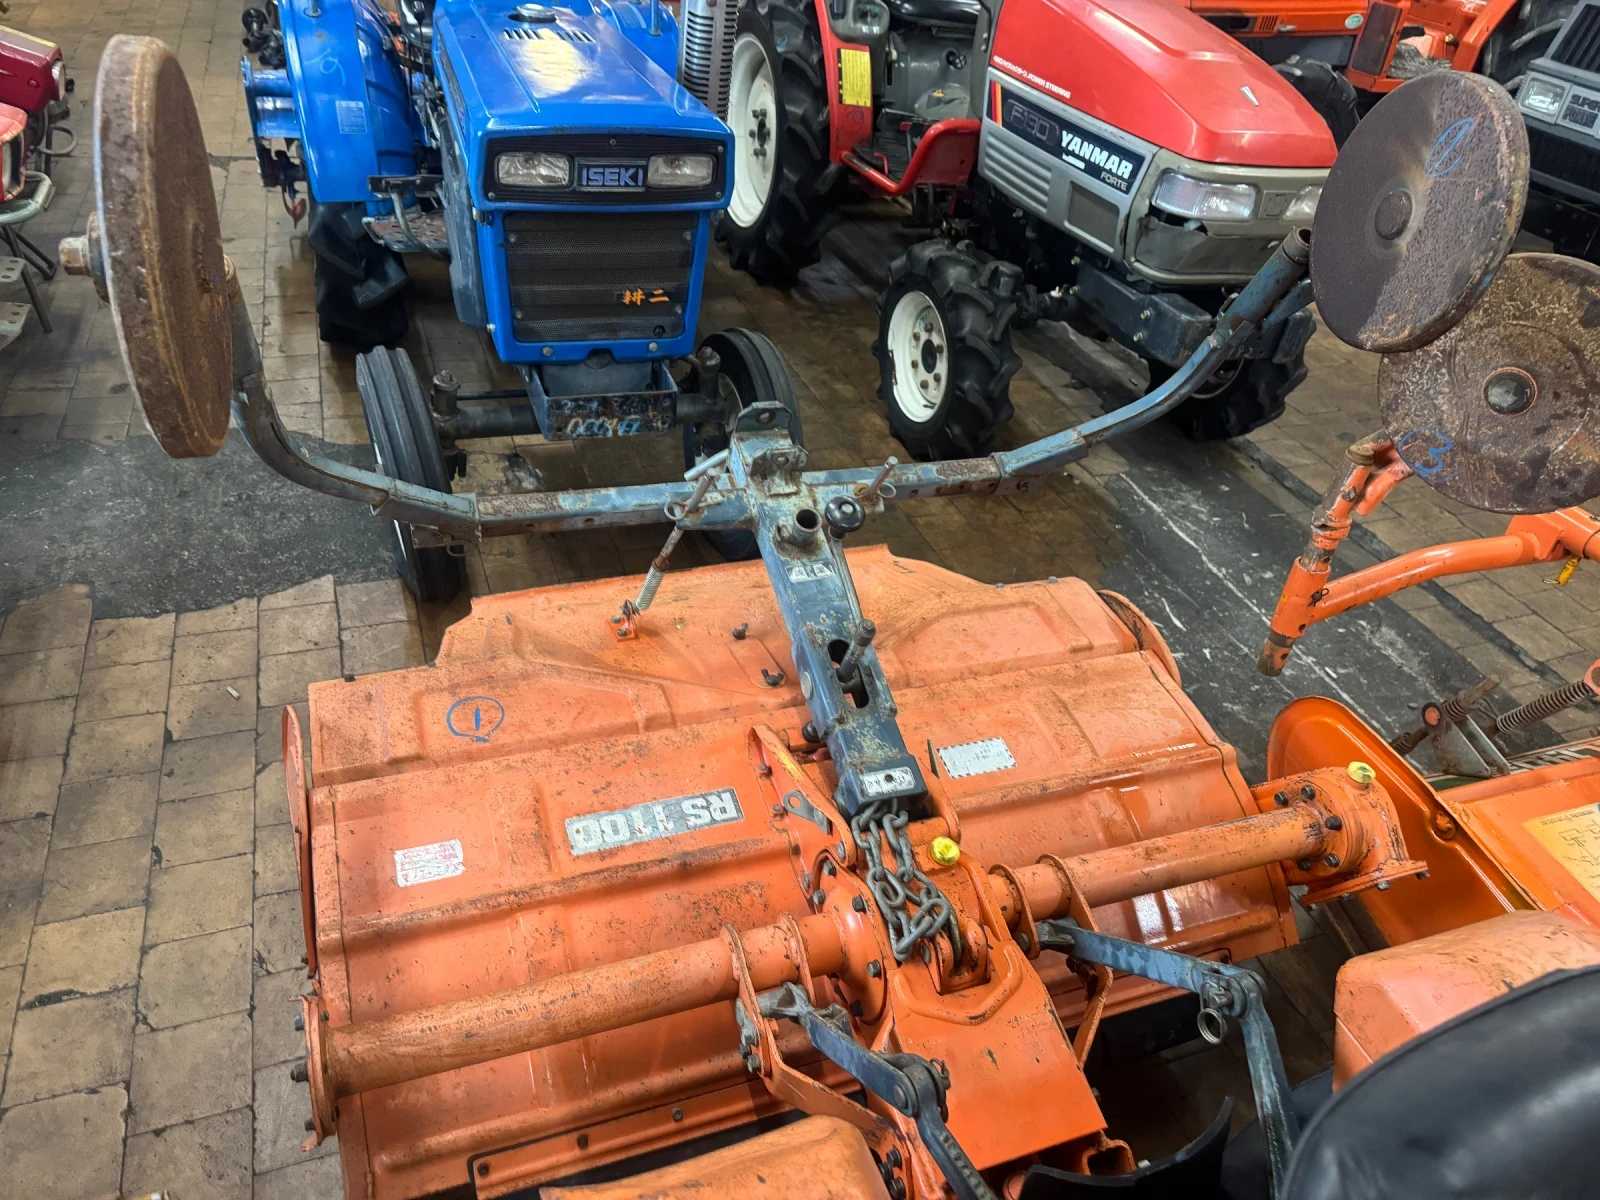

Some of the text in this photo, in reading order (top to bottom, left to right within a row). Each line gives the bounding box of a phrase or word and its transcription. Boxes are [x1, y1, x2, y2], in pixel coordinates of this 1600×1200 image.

[1061, 130, 1134, 180] YANMAR
[581, 167, 644, 187] ISEKI
[1100, 172, 1129, 191] FORTE
[573, 791, 739, 849] RS 1100
